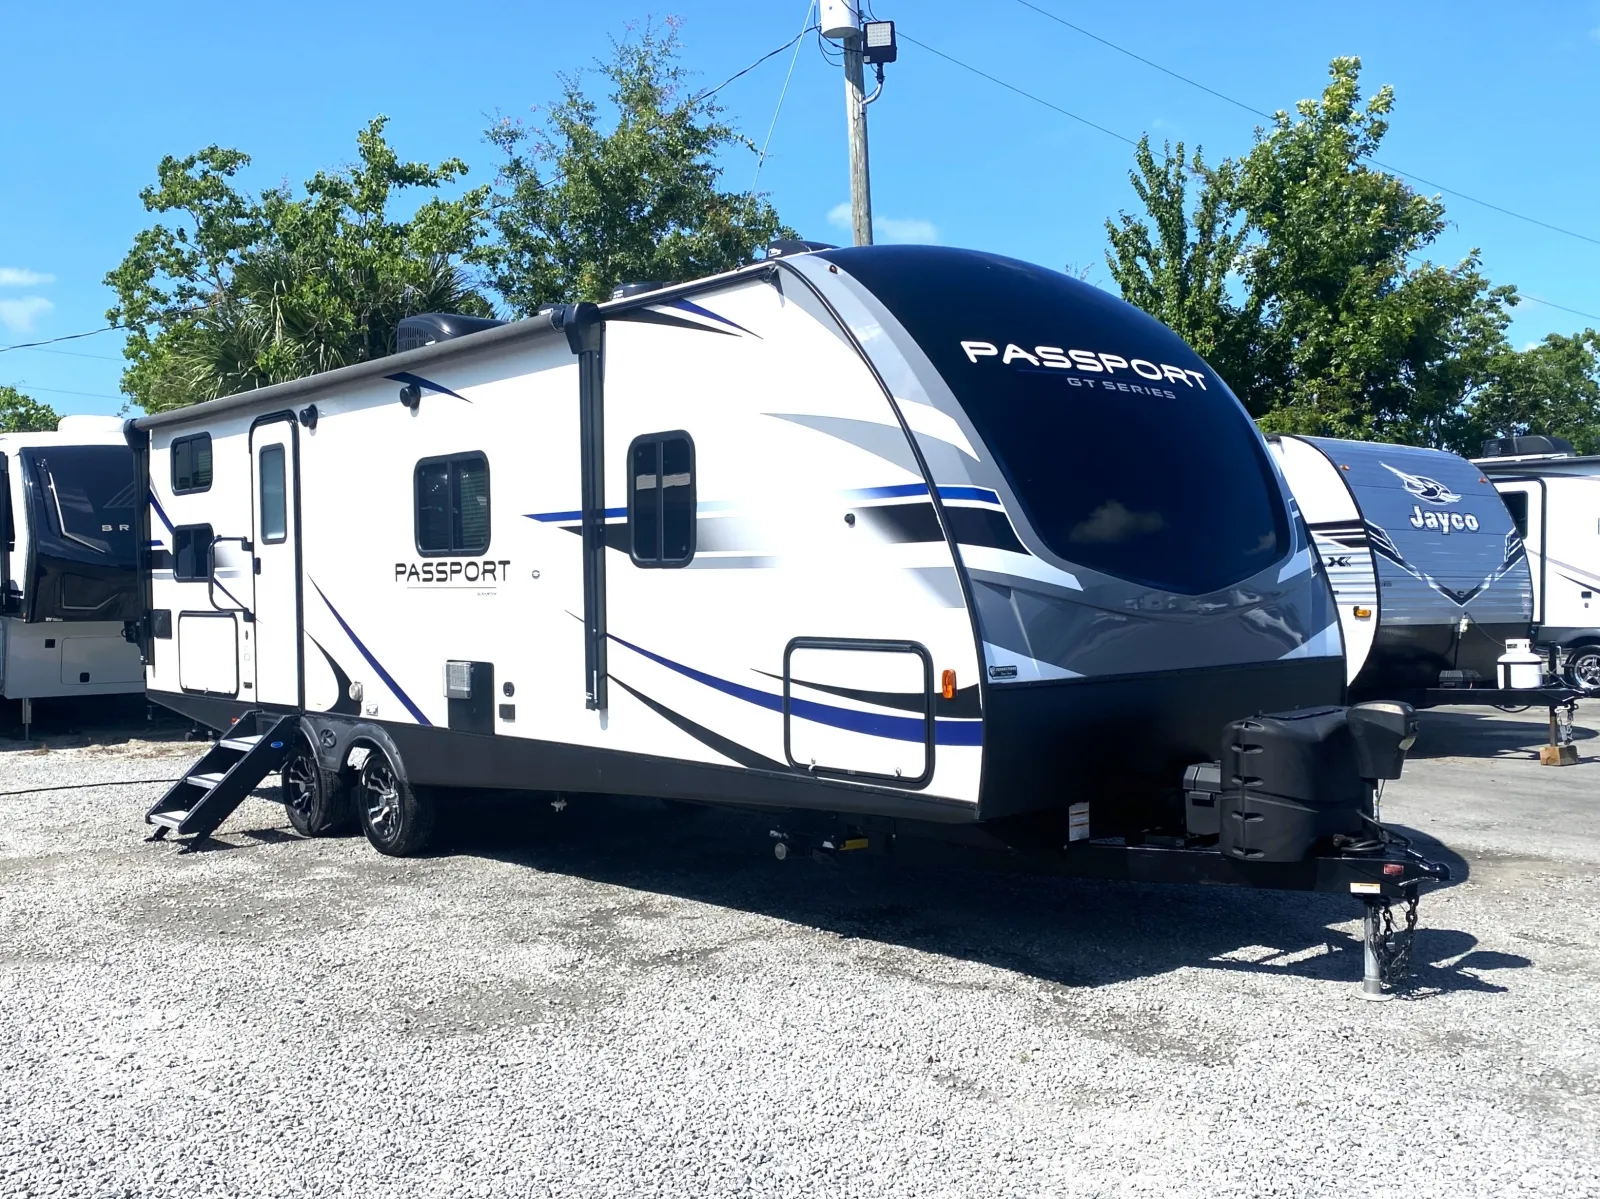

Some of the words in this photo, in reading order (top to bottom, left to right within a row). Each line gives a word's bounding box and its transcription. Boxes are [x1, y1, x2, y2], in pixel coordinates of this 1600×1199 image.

[960, 340, 1207, 391] PASSPORT
[1066, 377, 1096, 388] GT
[1102, 380, 1177, 400] SERIES
[1409, 504, 1480, 535] Jayco
[395, 560, 511, 582] PASSPORT
